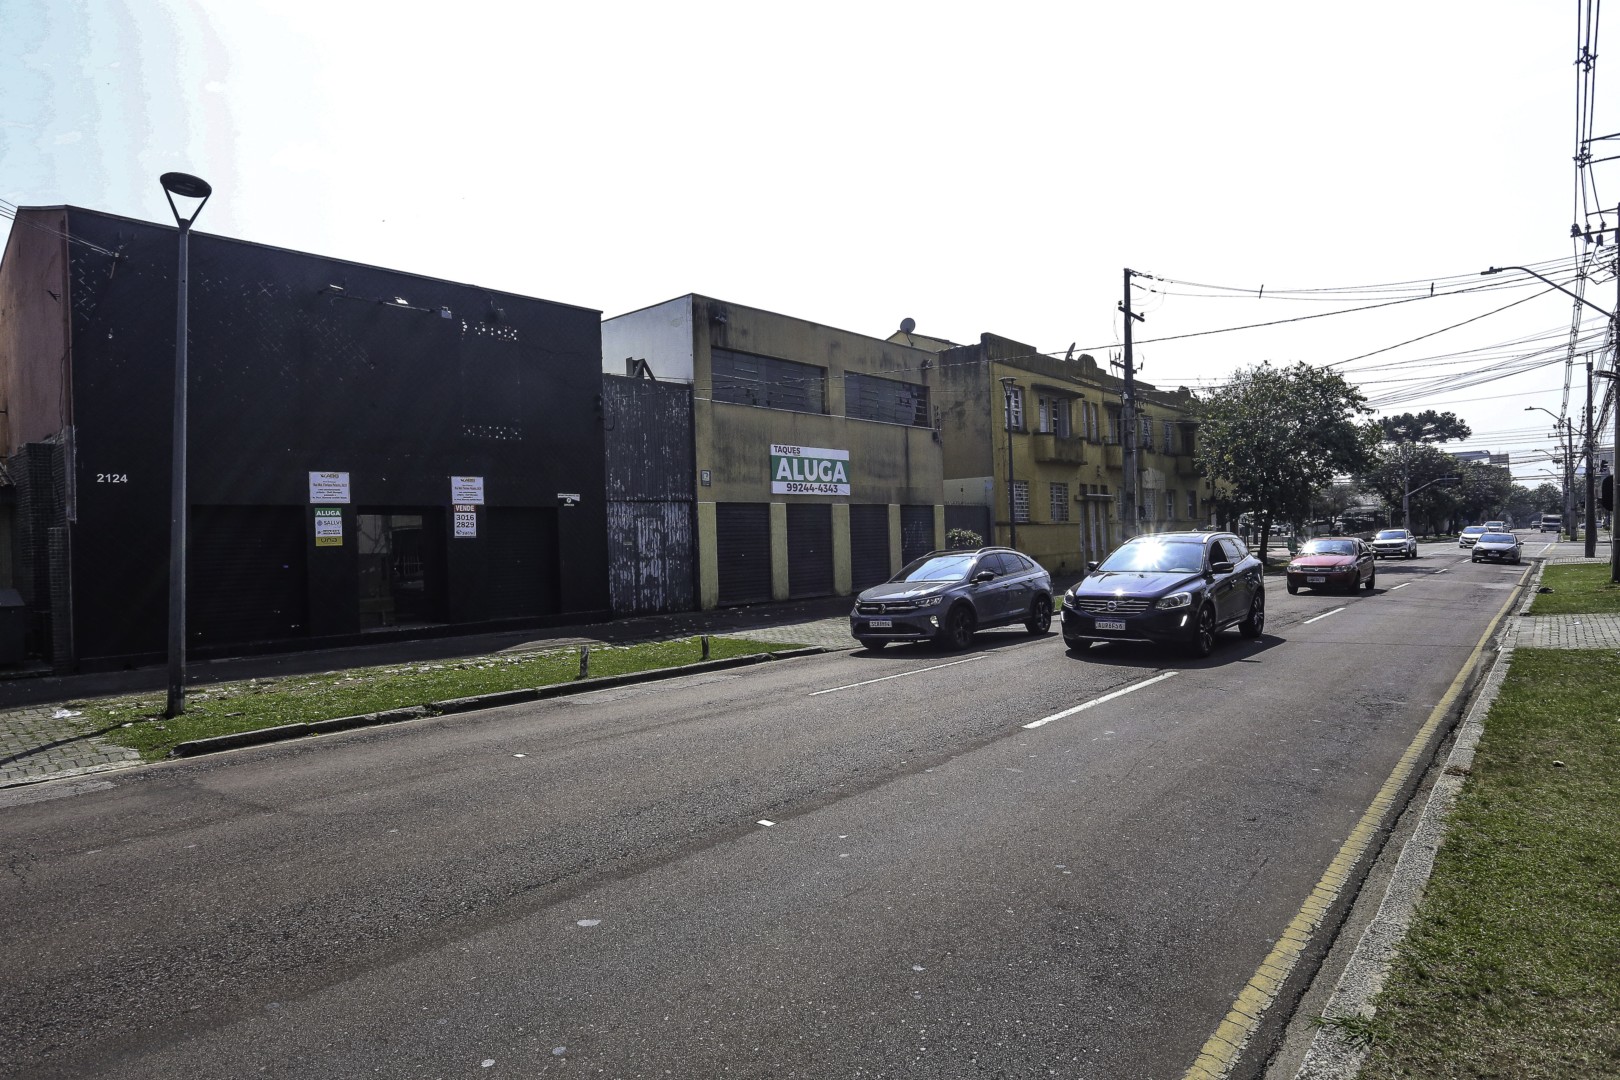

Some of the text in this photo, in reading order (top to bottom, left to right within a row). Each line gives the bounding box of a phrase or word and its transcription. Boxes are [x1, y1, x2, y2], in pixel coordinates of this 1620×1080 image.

[773, 446, 801, 454] TAQUES
[776, 457, 848, 483] ALUGA
[96, 473, 128, 483] 2124
[786, 483, 838, 493] 99244-4343
[455, 504, 475, 512] VENDE
